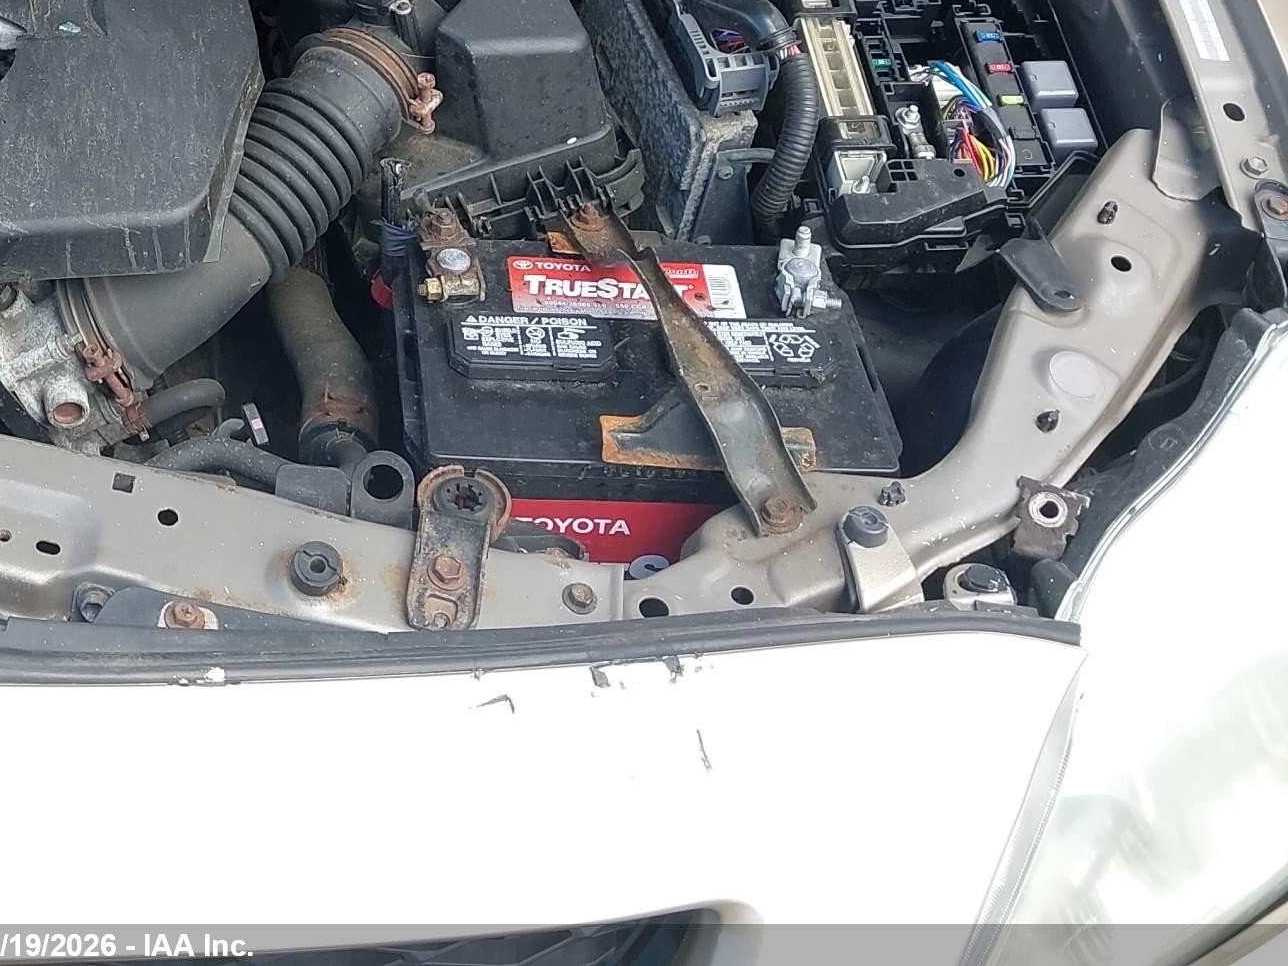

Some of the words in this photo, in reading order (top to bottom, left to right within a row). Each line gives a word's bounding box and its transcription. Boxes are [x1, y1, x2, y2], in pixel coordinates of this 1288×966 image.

[535, 262, 591, 272] TOYOTA
[478, 316, 529, 324] DANGER
[541, 317, 587, 326] POISON
[515, 517, 631, 535] OYOTA
